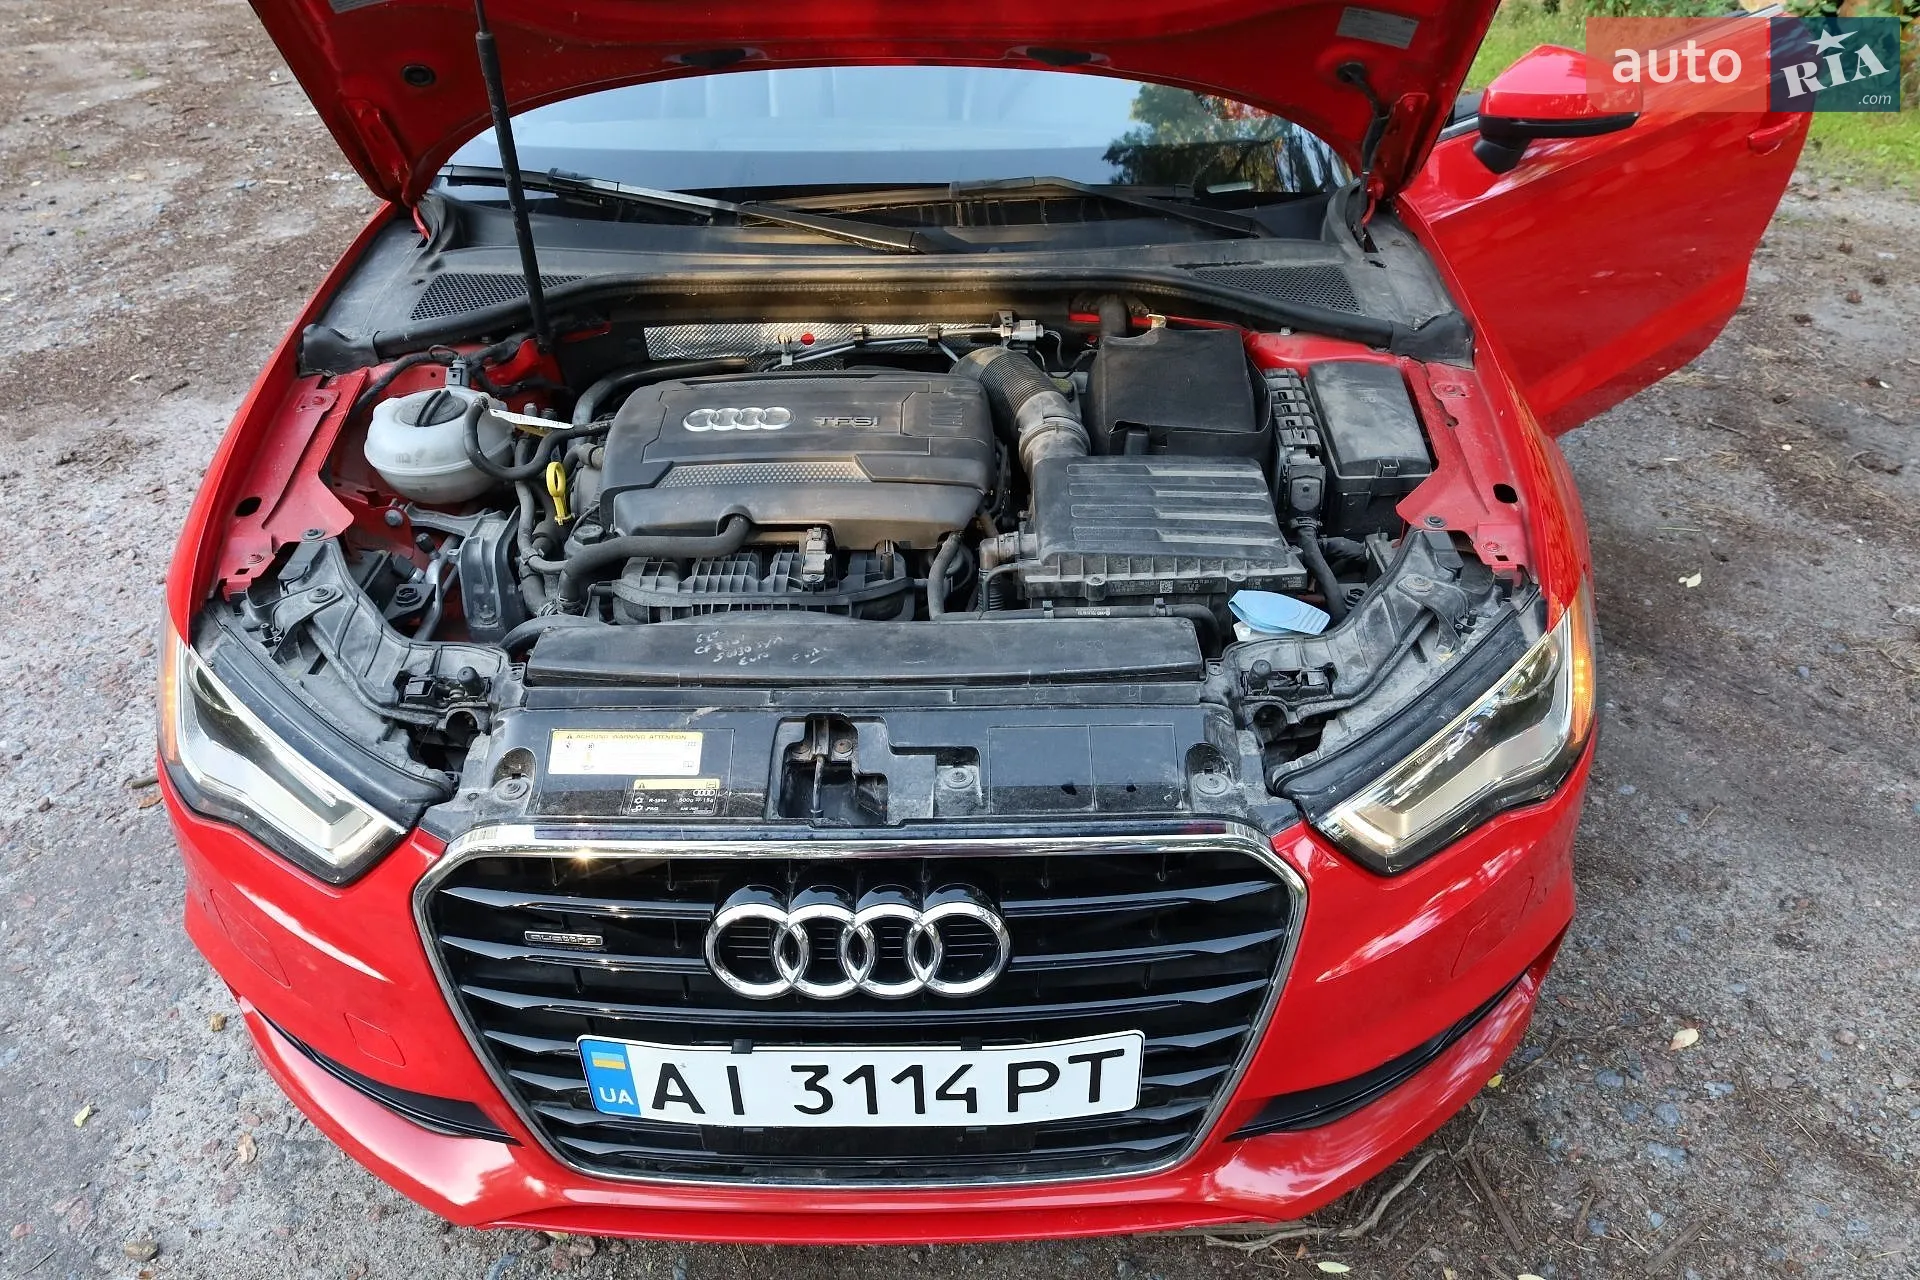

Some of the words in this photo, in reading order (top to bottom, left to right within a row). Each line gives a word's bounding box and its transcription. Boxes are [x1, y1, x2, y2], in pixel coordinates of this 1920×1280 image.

[814, 416, 878, 428] TFSI
[651, 1063, 745, 1115] AI
[791, 1064, 977, 1114] 3114
[1008, 1049, 1125, 1112] PT
[599, 1086, 634, 1105] UA
